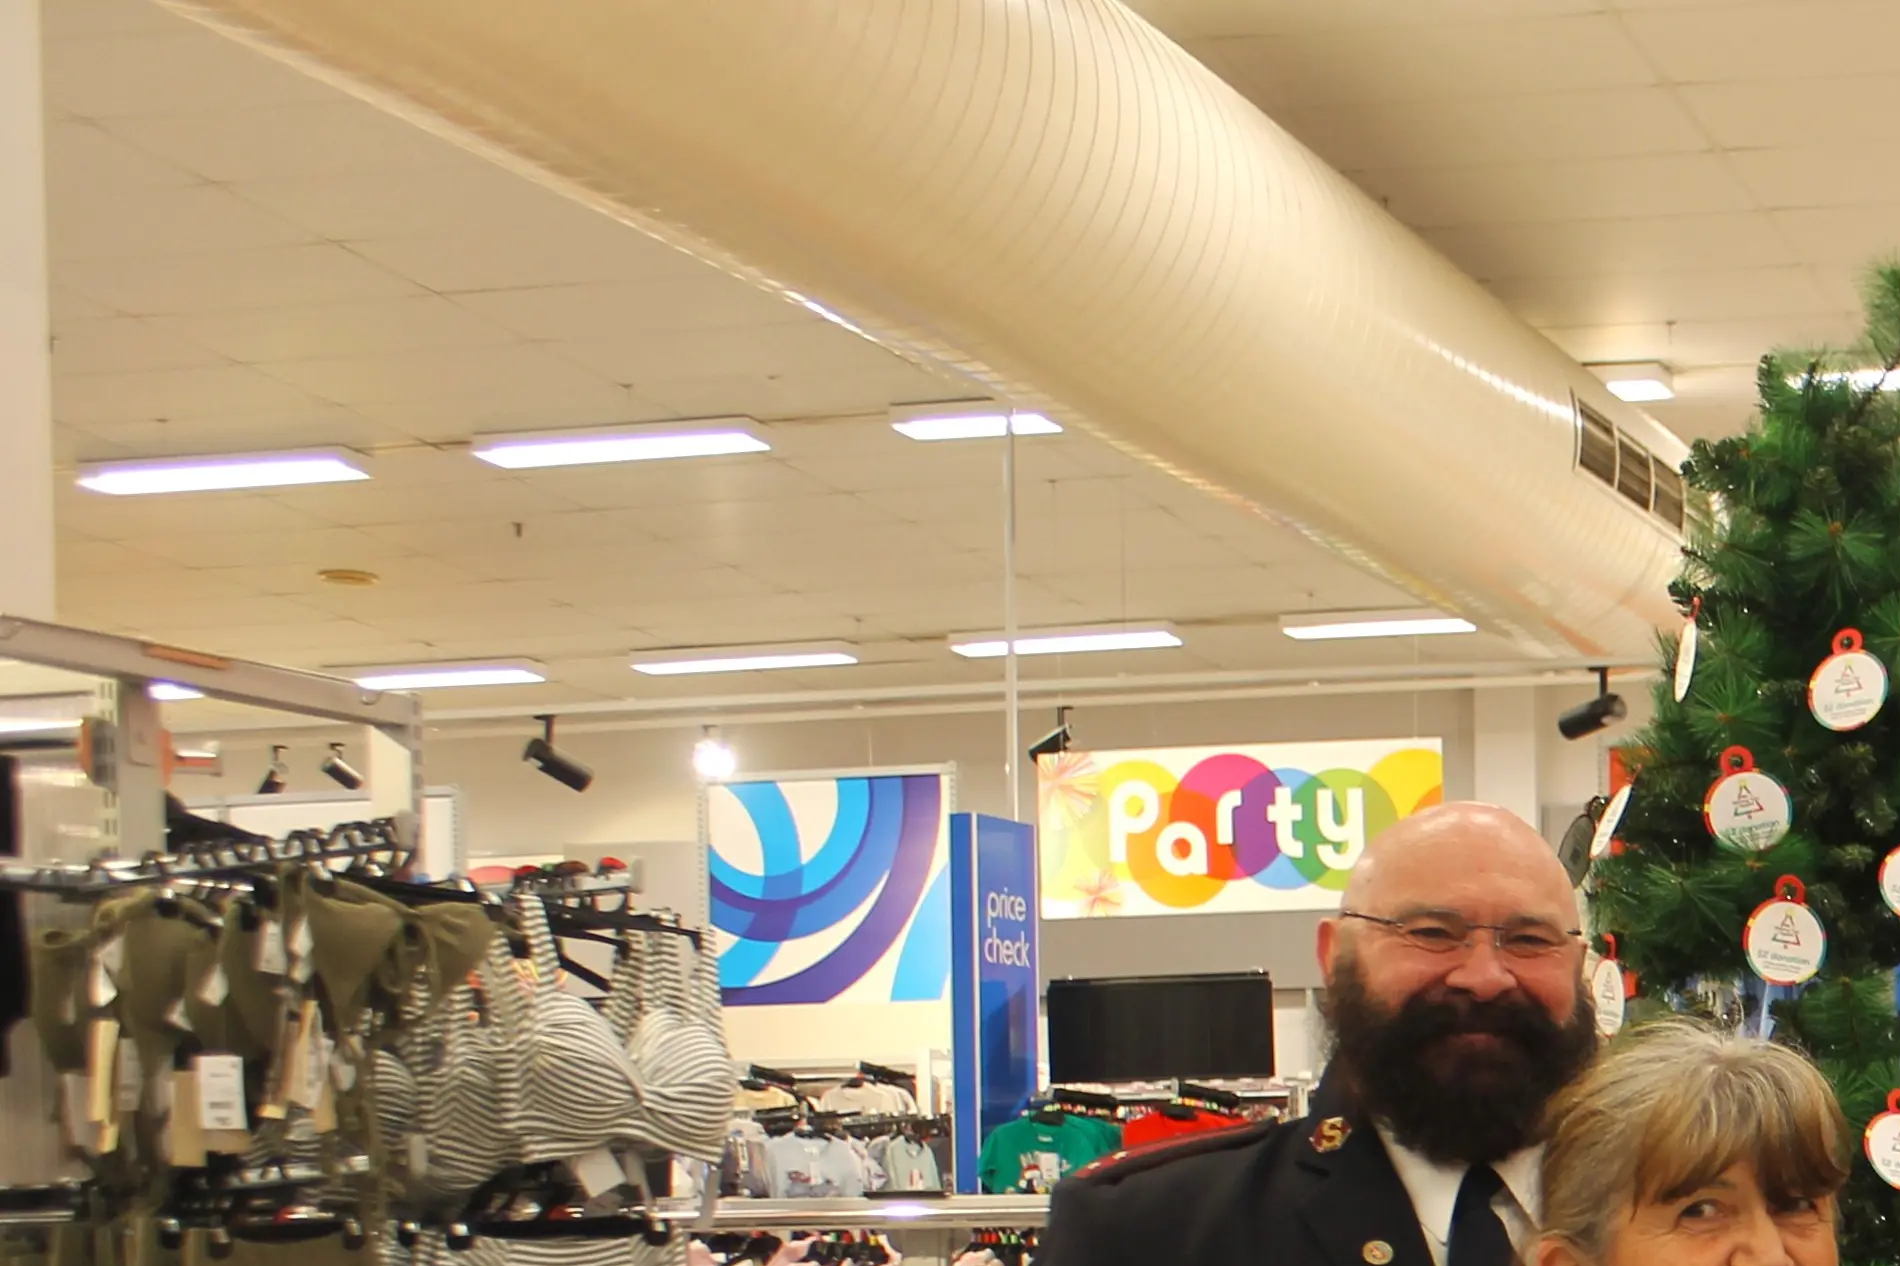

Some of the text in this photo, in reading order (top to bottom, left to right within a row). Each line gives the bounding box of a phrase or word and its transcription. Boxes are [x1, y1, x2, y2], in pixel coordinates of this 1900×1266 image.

[987, 886, 1027, 928] price
[984, 926, 1031, 968] check
[1322, 1116, 1344, 1150] S
